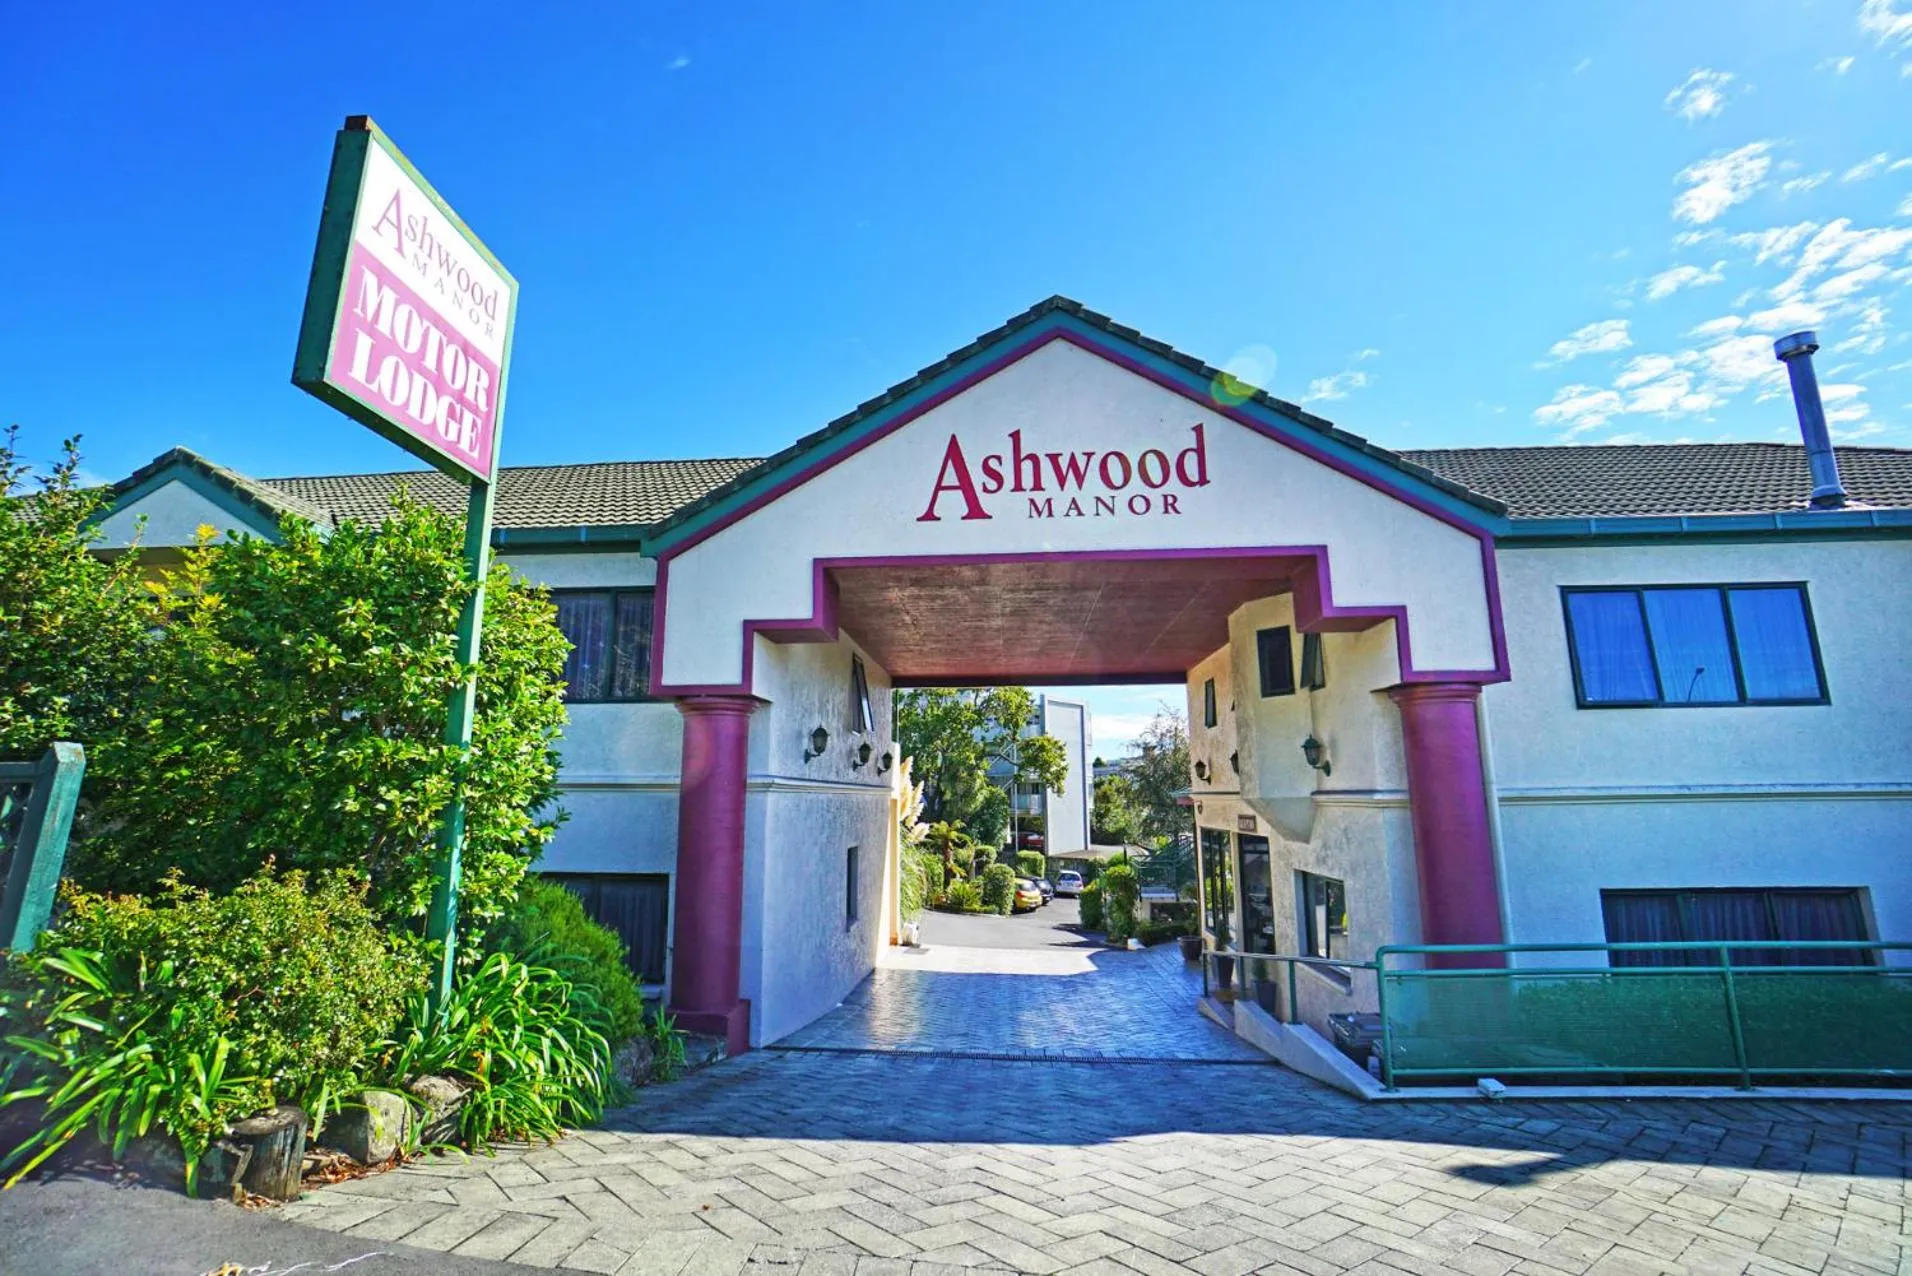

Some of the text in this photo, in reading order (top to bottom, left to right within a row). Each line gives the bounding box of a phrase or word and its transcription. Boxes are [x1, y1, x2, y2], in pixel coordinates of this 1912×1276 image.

[372, 189, 498, 320] Ashwood
[412, 253, 494, 339] MANOR
[349, 329, 482, 459] LODGE
[353, 267, 489, 411] MOTOR
[916, 423, 1210, 521] Ashwood
[1028, 493, 1182, 519] MANOR
